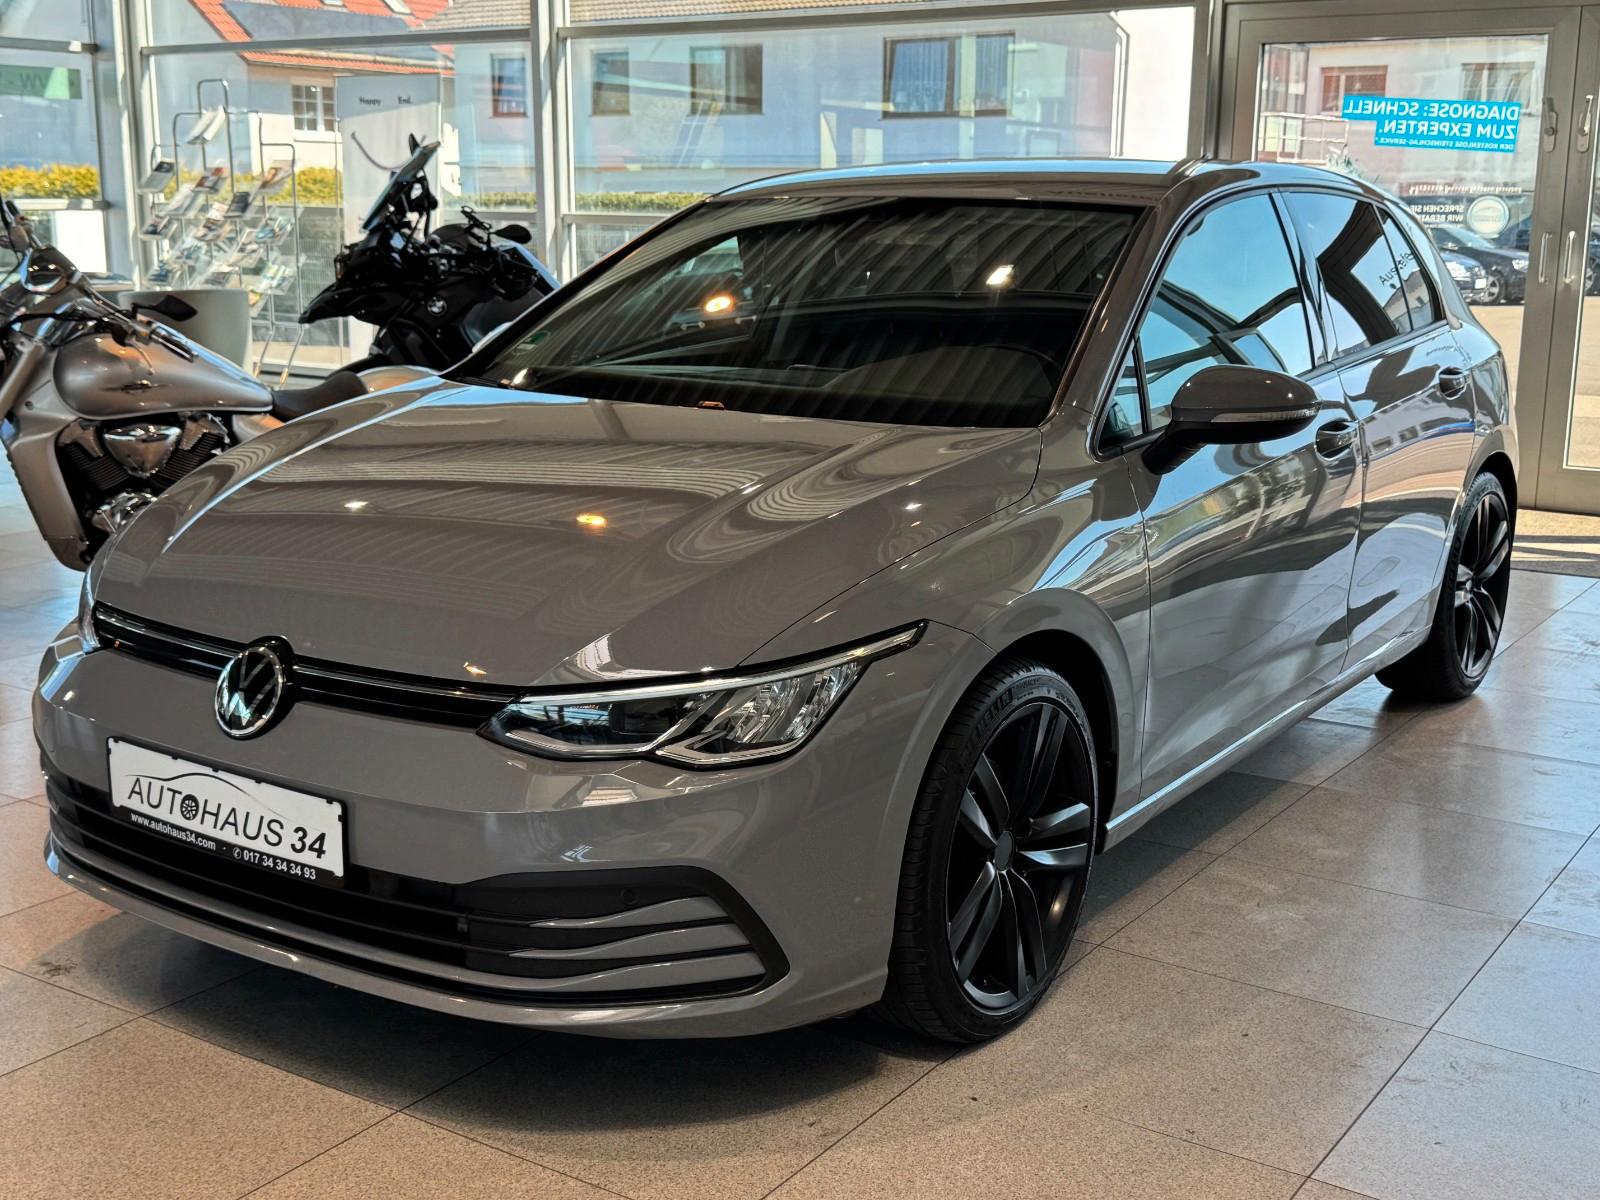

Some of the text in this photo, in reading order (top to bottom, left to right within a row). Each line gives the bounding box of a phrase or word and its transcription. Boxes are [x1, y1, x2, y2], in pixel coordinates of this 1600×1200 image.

[128, 777, 327, 859] AUTOHAUS 34
[130, 812, 316, 880] www.autohaus34.com 017 34 34 34 93
